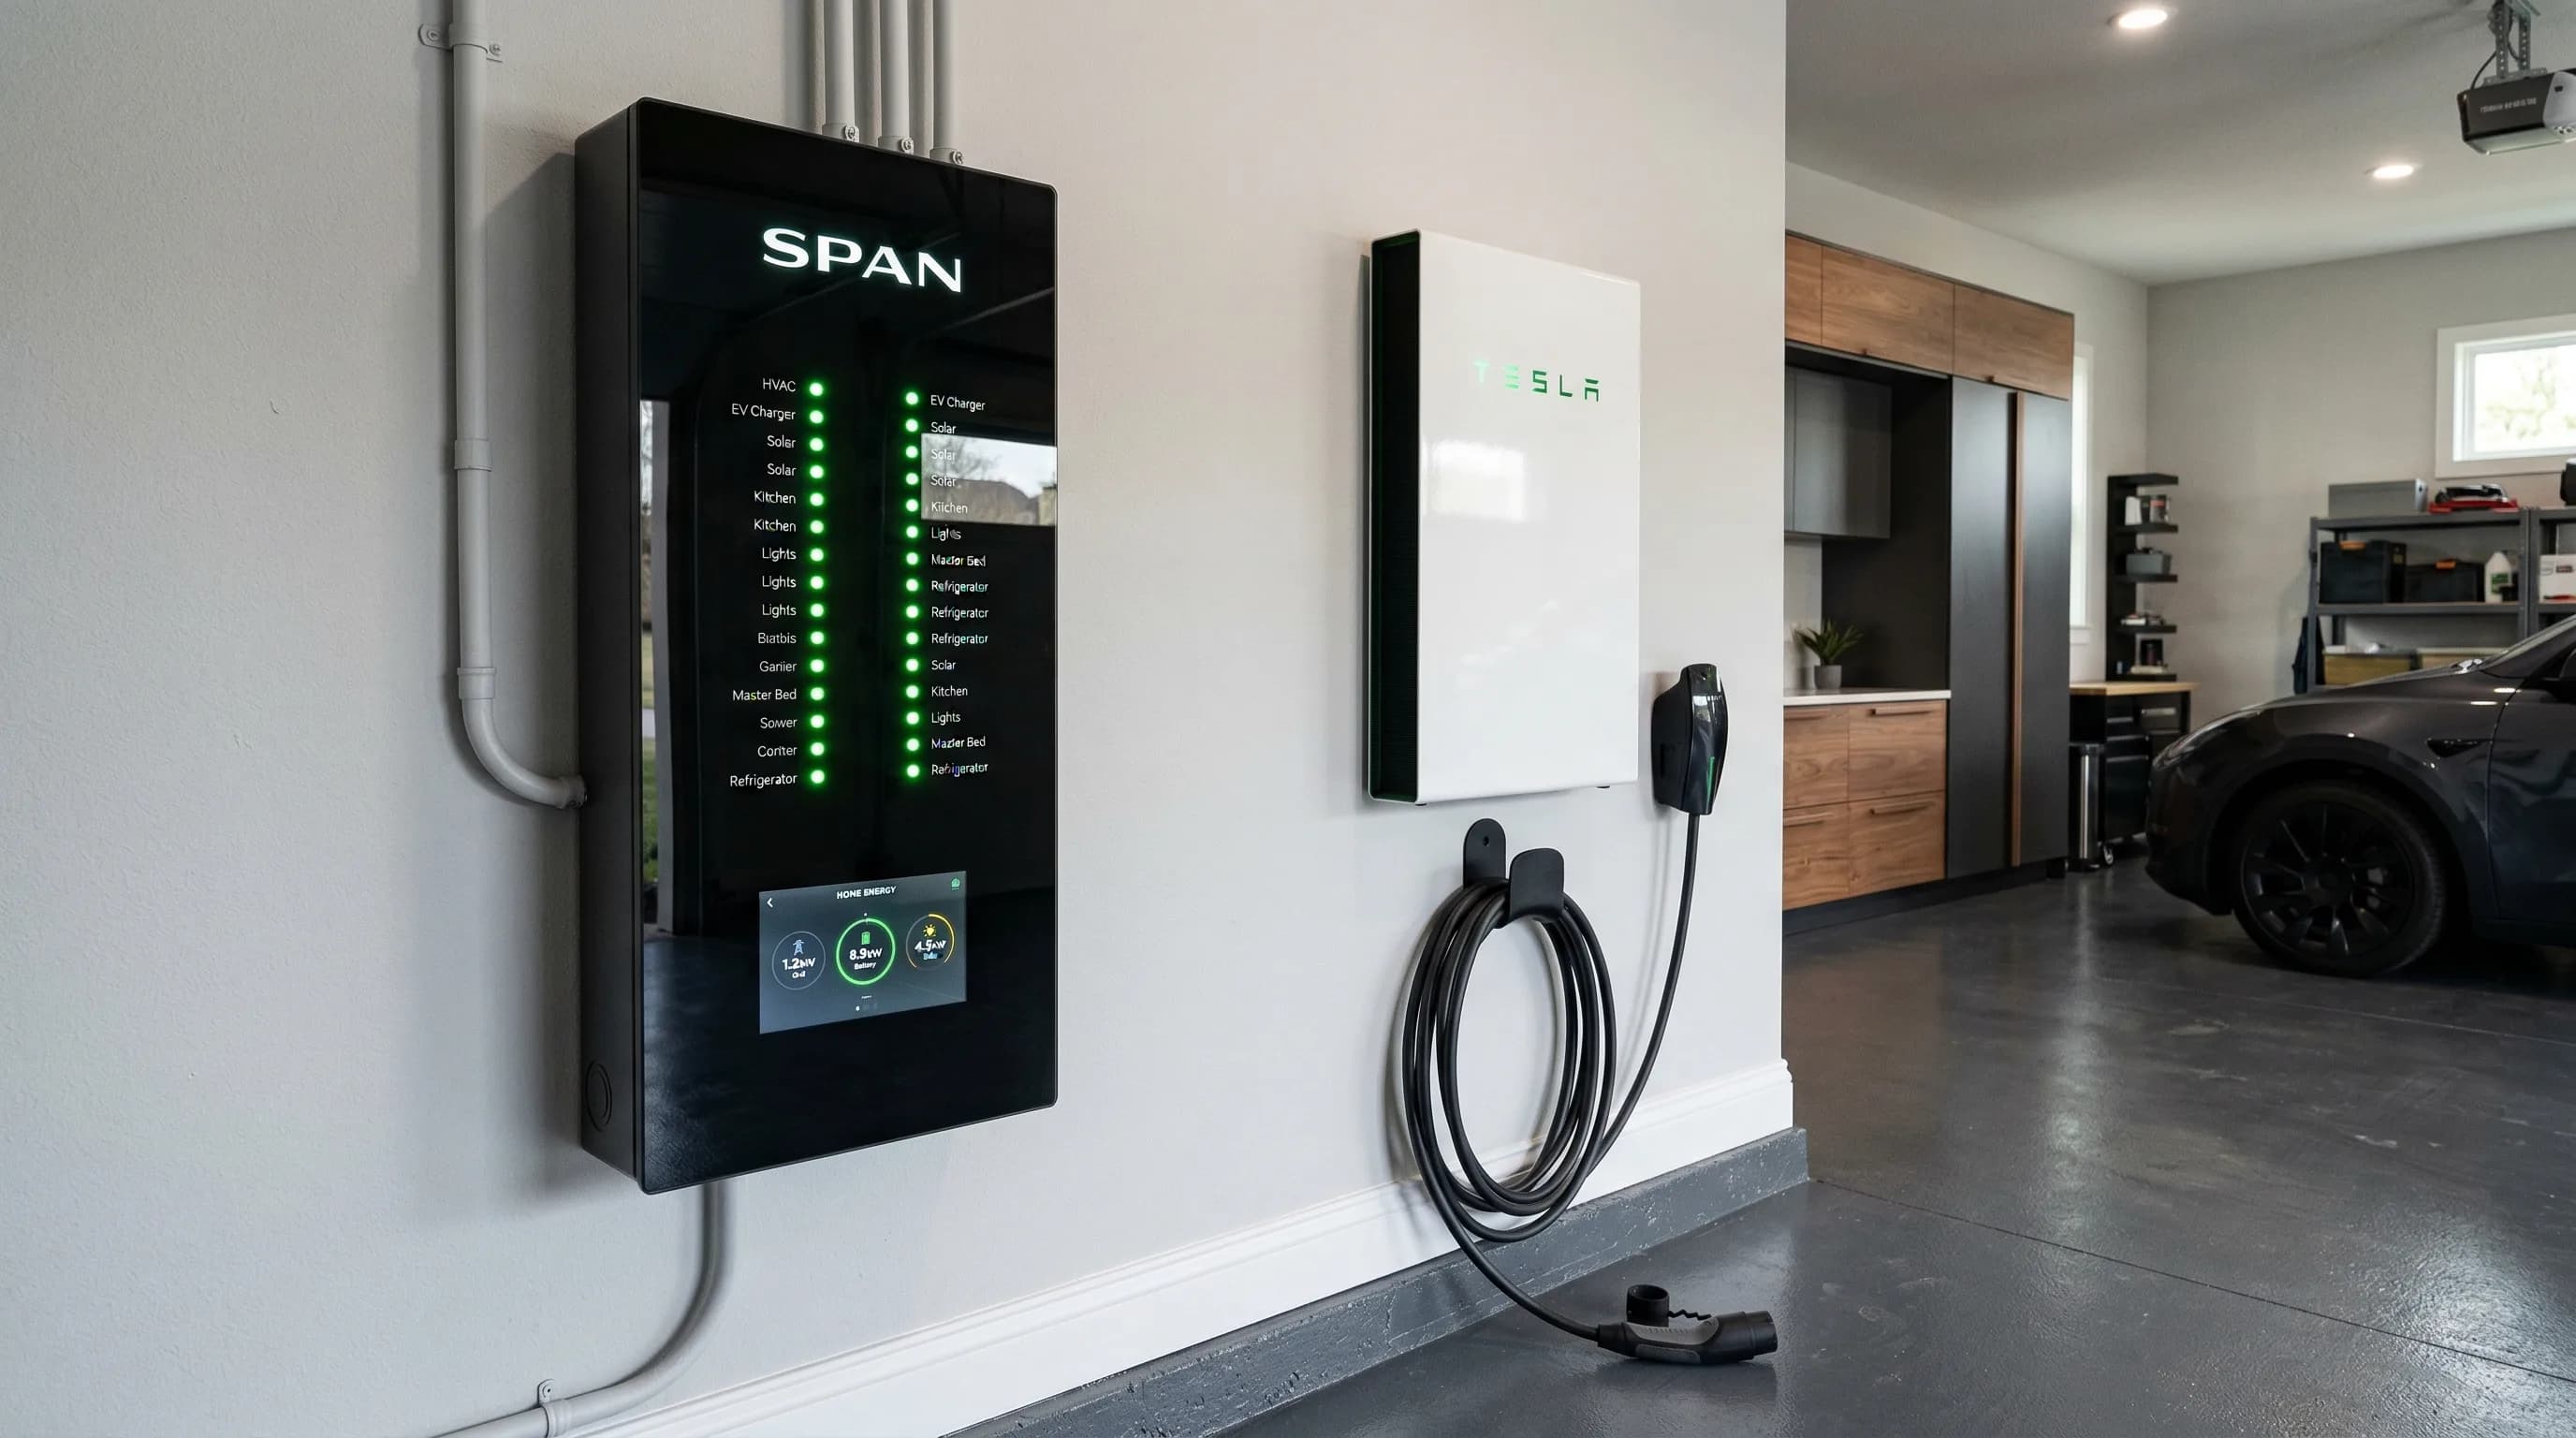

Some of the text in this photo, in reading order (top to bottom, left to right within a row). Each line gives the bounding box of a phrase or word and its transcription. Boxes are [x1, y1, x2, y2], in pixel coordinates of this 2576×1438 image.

[763, 227, 961, 293] SPAN
[763, 377, 797, 392] HVAC
[1472, 360, 1600, 403] TESLA
[930, 394, 987, 412] EV Charger
[731, 403, 796, 421] EV Charger
[930, 420, 957, 434] Solar
[767, 462, 797, 477] Solar
[754, 490, 797, 504] Kitchen
[754, 518, 797, 533] Kitchen
[762, 603, 797, 619] Lights
[930, 632, 988, 647] Refrigerator
[732, 688, 798, 701] Master Bed
[930, 684, 968, 697] Kitchen
[930, 711, 962, 726] Lights
[966, 735, 987, 748] Bed
[730, 773, 798, 789] Refrigerator
[863, 886, 897, 897] ENERGY
